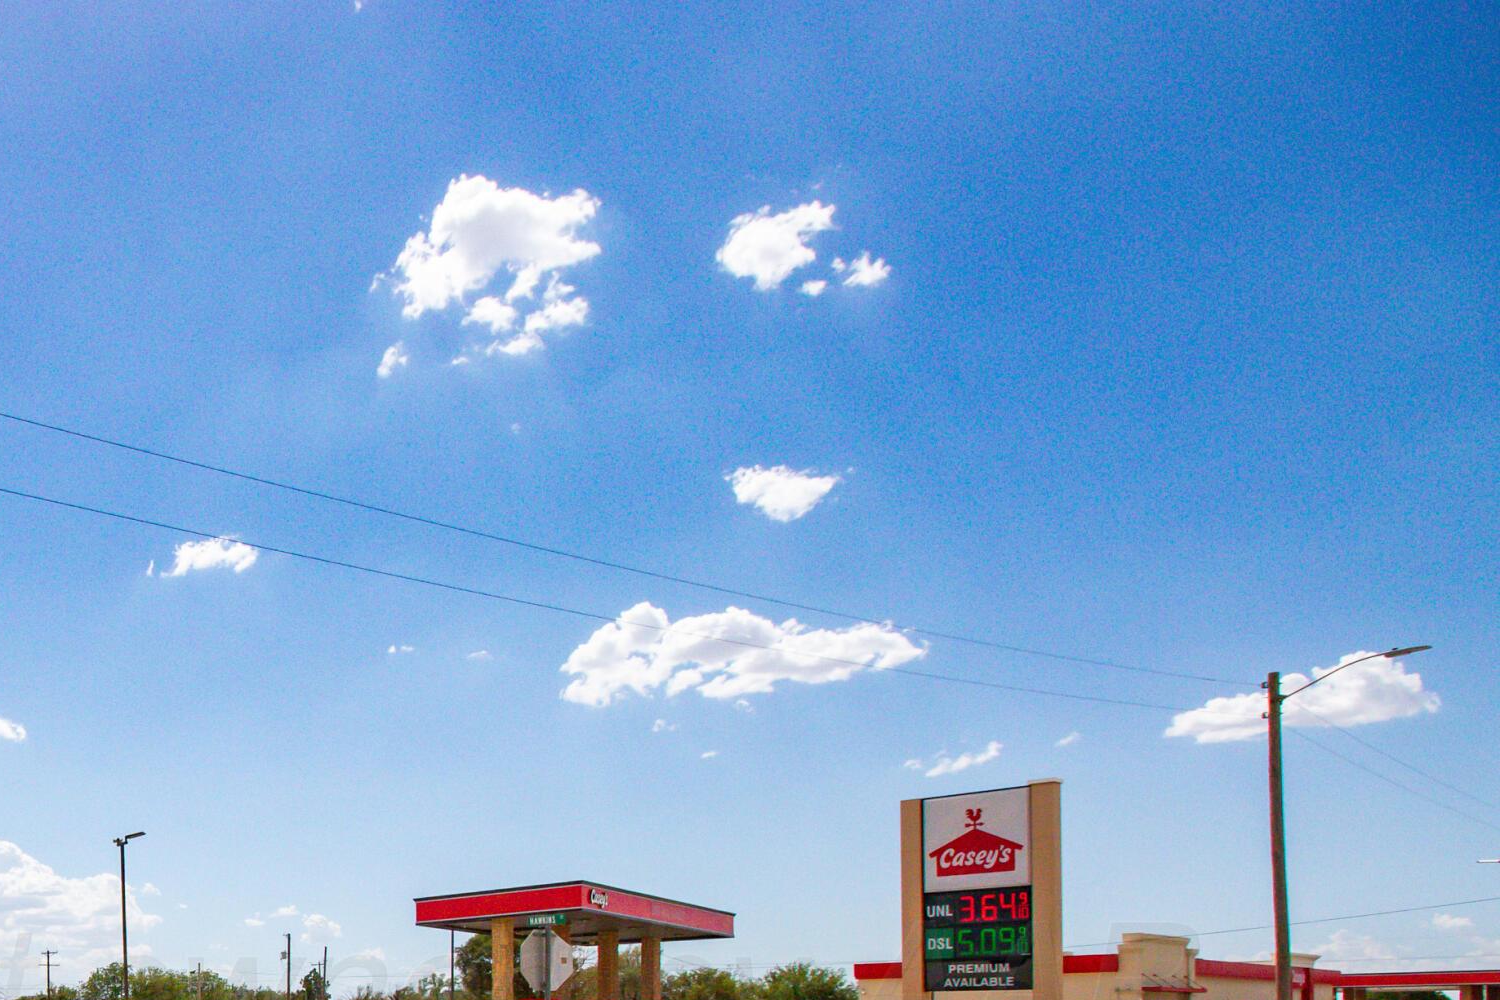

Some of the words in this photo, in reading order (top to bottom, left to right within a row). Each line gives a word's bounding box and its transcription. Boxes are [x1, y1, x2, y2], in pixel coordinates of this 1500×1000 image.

[940, 845, 1011, 869] Casey's
[926, 904, 954, 918] UNL
[959, 892, 1017, 923] 3.64
[529, 914, 556, 925] HAWKINS
[927, 937, 954, 950] DSL
[957, 927, 1015, 957] 5.09
[947, 963, 1010, 974] PREMIUM
[943, 976, 1015, 987] AVAILABLE
